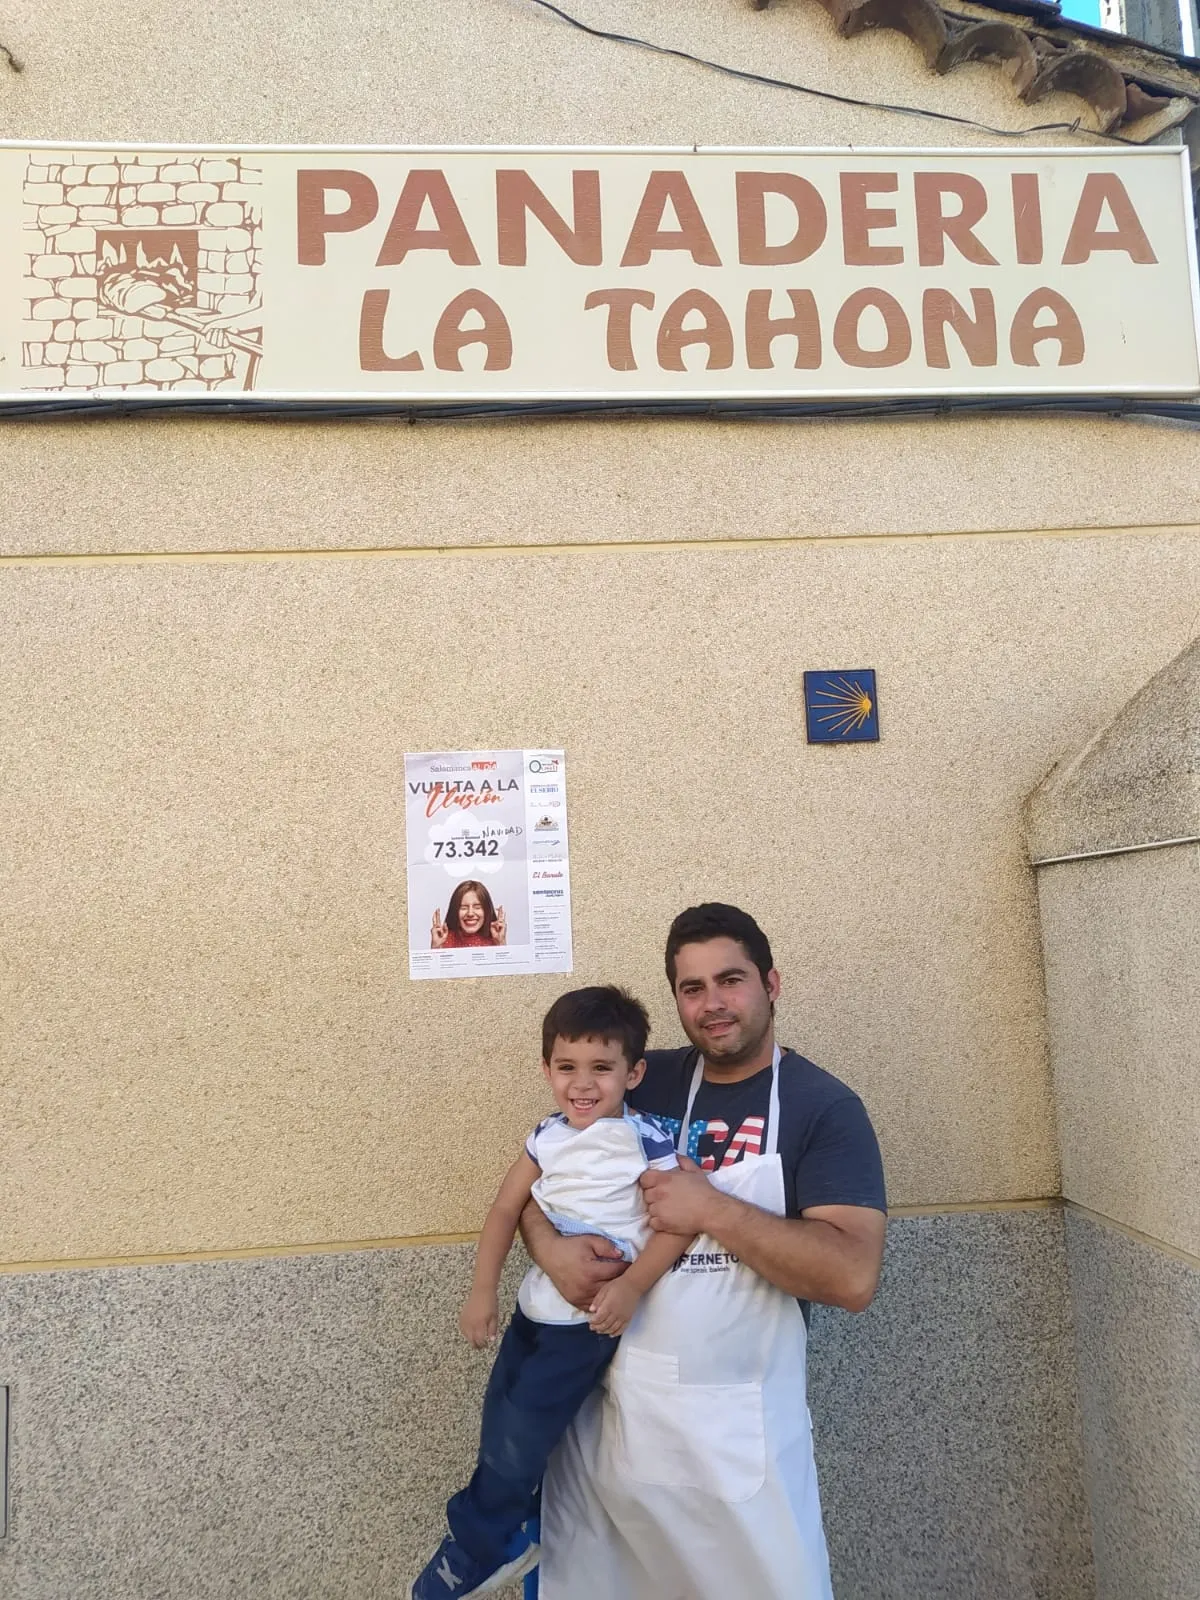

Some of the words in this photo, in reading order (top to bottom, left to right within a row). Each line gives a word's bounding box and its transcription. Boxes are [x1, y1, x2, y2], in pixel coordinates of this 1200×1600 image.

[297, 169, 1159, 267] PANADERIA
[359, 288, 513, 372] LA
[584, 286, 1085, 371] TAHONA
[408, 780, 475, 794] VUELTA
[480, 779, 493, 793] A
[497, 778, 519, 791] LA
[482, 826, 523, 838] NAVIDAD
[433, 839, 499, 858] 73.342
